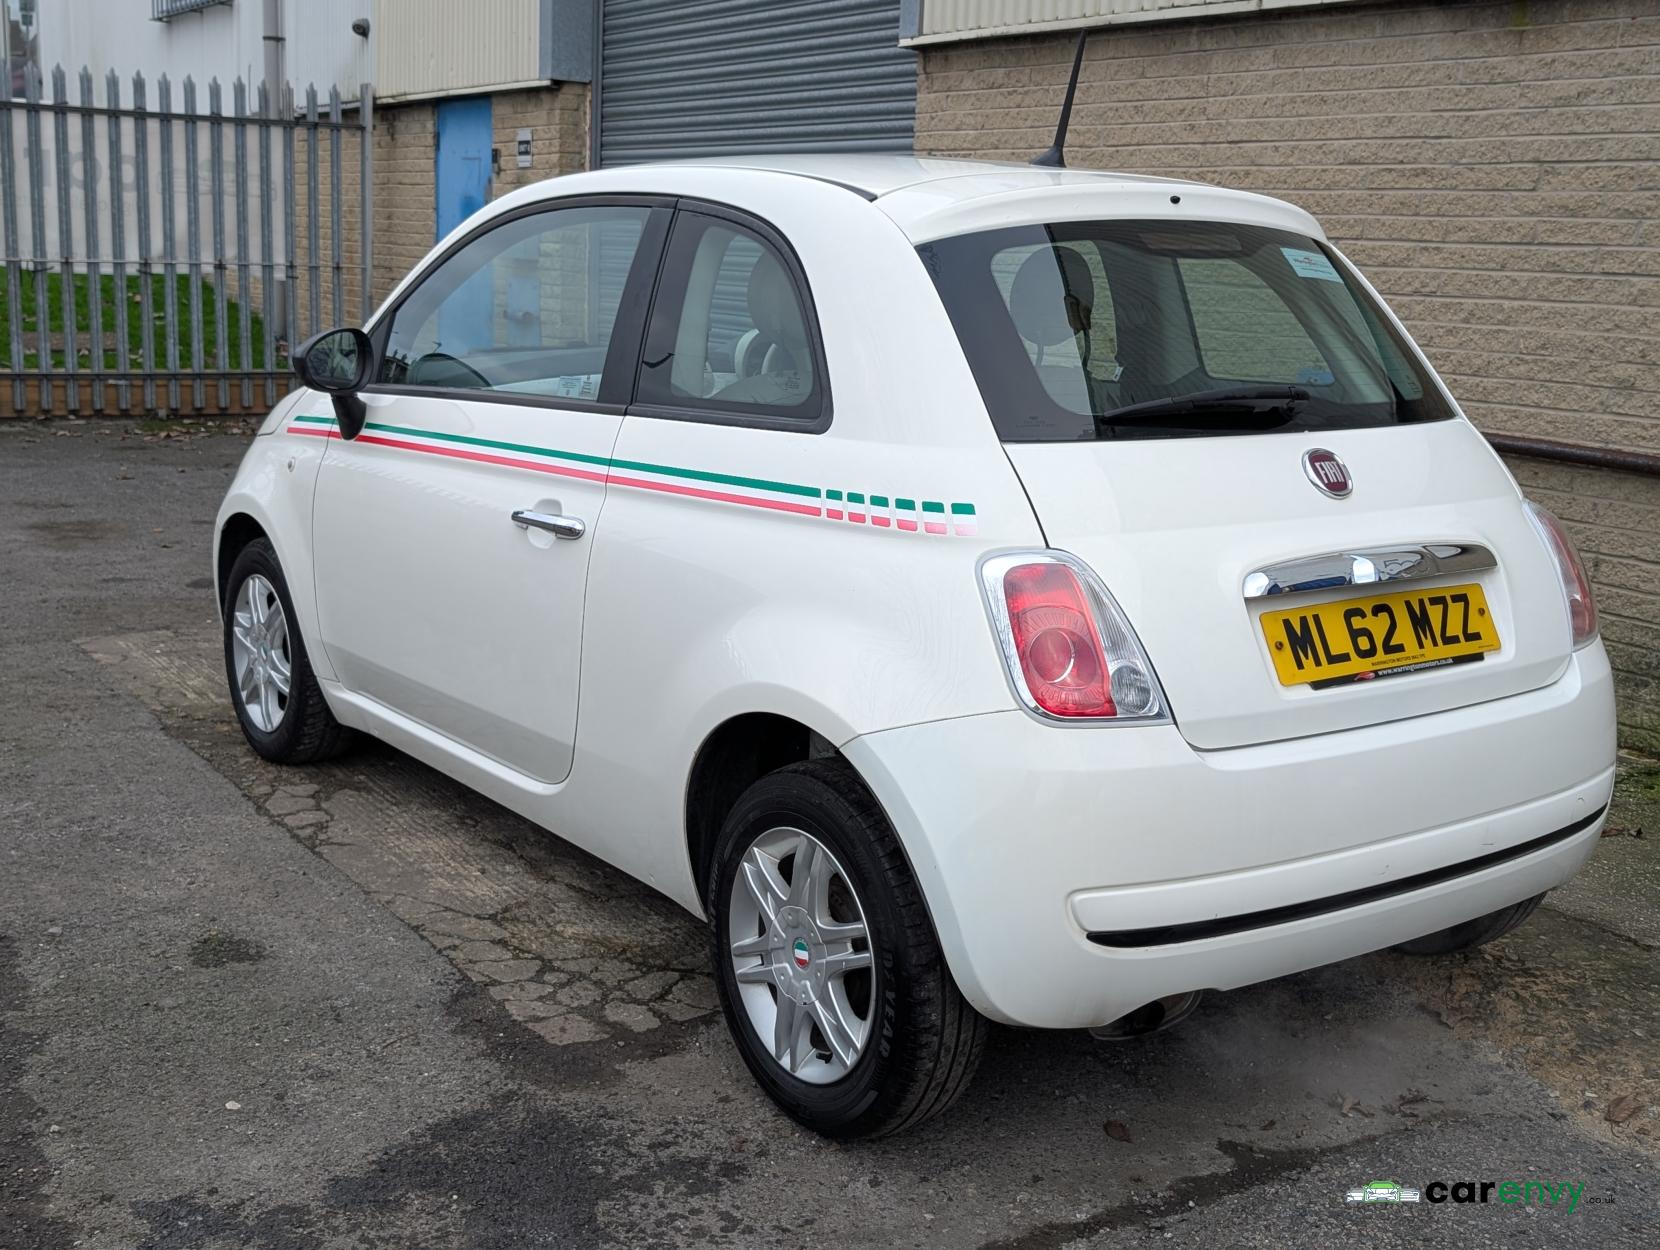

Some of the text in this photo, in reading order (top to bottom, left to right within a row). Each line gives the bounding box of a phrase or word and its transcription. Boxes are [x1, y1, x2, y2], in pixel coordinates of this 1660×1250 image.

[1314, 460, 1346, 484] FIAT
[1282, 593, 1482, 670] ML62 MZZ
